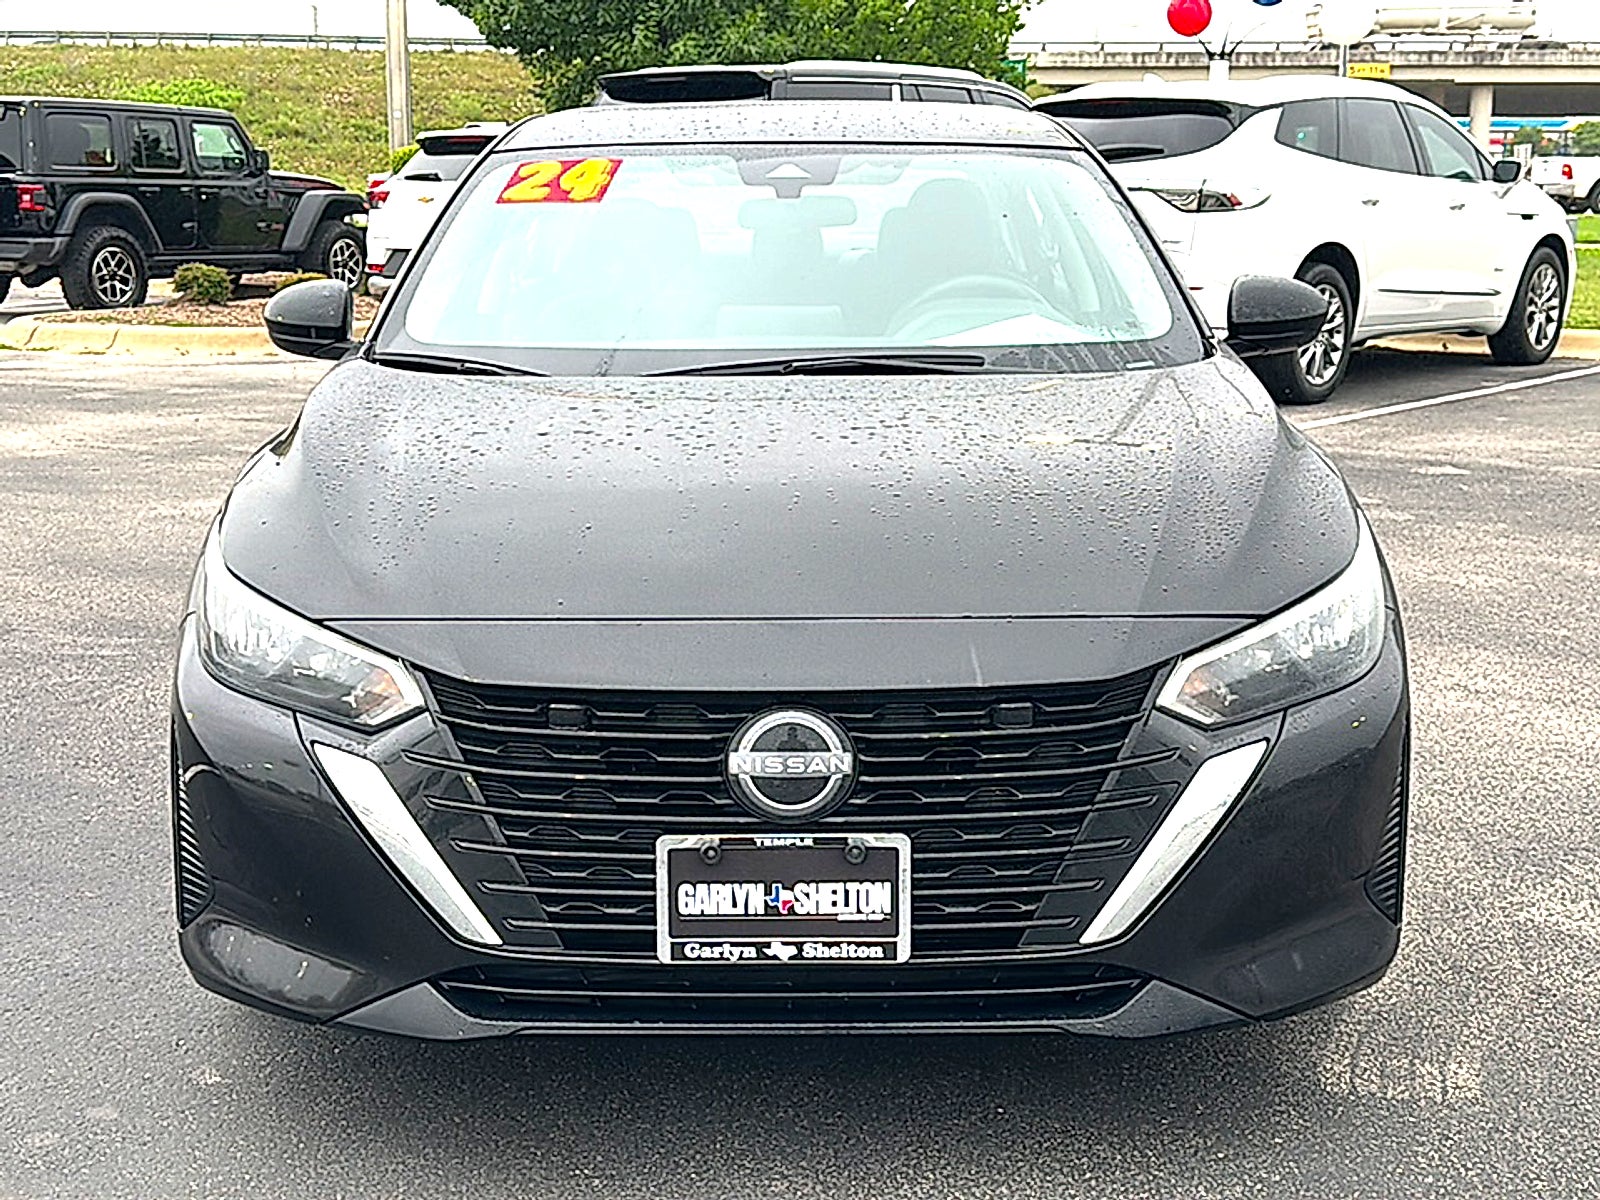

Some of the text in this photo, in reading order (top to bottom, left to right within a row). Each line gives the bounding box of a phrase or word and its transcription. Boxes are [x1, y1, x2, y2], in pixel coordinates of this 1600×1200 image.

[501, 158, 612, 201] 24
[729, 755, 849, 774] NISSAN
[754, 837, 814, 847] TEMPLE
[677, 881, 892, 915] GARLYN SHELTON
[684, 942, 884, 962] Garlyn Shelton
